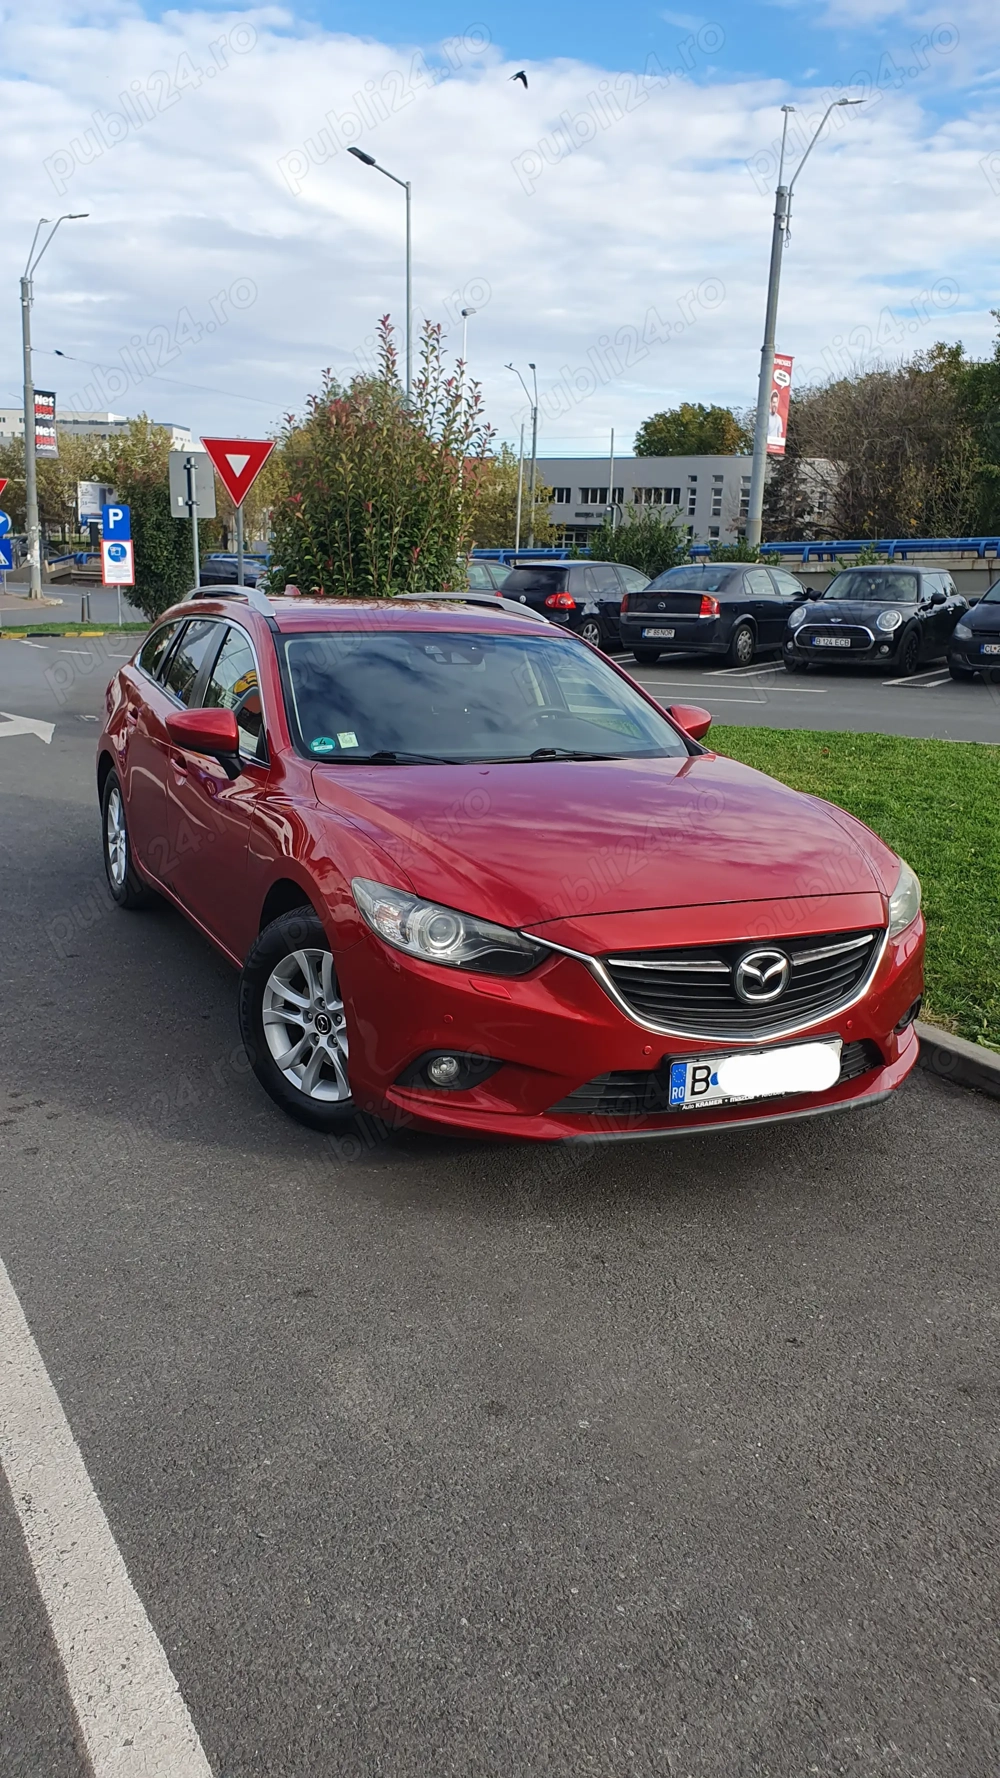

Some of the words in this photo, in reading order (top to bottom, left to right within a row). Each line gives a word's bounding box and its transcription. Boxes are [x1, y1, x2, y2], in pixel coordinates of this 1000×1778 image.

[35, 395, 54, 406] Net
[35, 405, 54, 414] Bet
[36, 426, 56, 436] Net
[36, 436, 56, 446] Bet
[108, 508, 123, 529] P
[984, 645, 994, 653] CL
[319, 738, 326, 746] 4
[690, 1065, 711, 1096] B
[672, 1086, 685, 1100] RO
[695, 1099, 723, 1109] KRAMER
